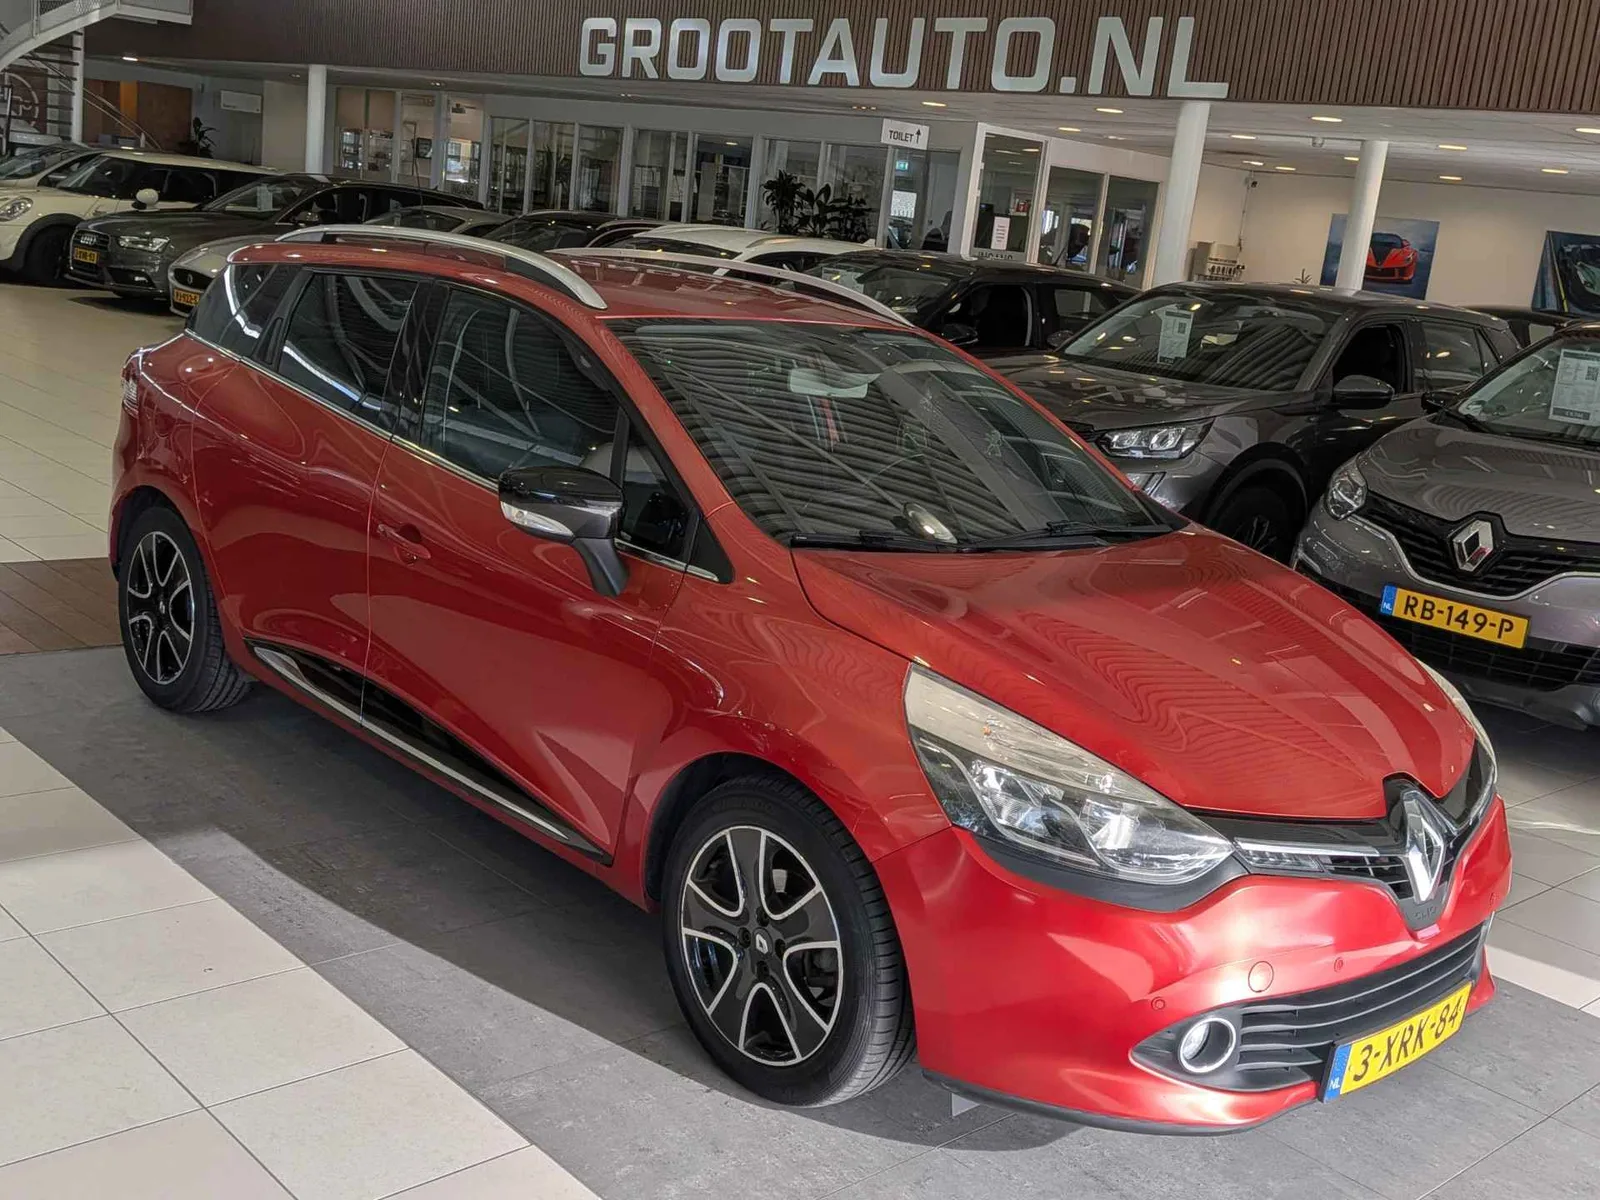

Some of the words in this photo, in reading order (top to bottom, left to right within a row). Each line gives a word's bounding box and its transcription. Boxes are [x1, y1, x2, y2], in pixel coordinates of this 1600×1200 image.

[579, 17, 1229, 99] GROOTAUTO.NL
[889, 129, 915, 142] TOILET
[1382, 602, 1393, 611] NL
[1403, 594, 1514, 639] RB-149-P
[1329, 1077, 1341, 1090] NL
[1352, 995, 1463, 1082] 3-XRK-84
